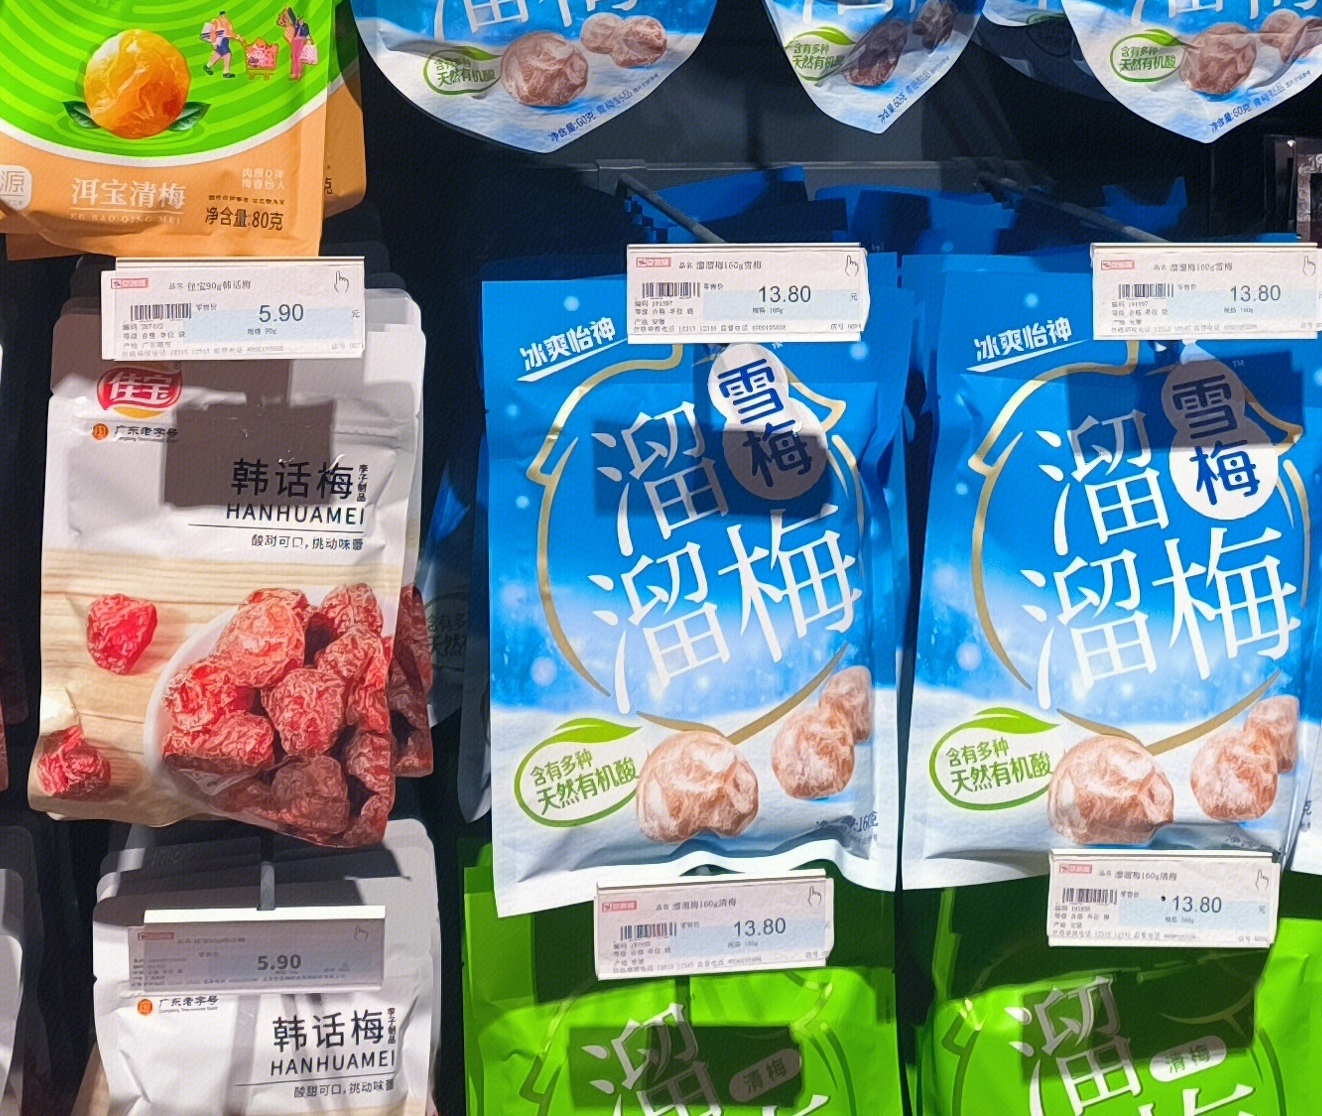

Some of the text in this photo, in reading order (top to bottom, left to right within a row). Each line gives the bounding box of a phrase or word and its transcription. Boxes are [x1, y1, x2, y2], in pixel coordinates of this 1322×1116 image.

[1118, 53, 1178, 73] 天然有机酸
[70, 176, 187, 211] 洱宝清梅
[204, 204, 284, 232] 净含量:80克
[259, 301, 305, 323] 5.90
[757, 283, 812, 304] 13.80
[1229, 283, 1282, 304] 13.80
[518, 314, 618, 372] 冰爽怡神
[974, 316, 1074, 362] 冰爽怡神
[105, 370, 177, 409] 佳宝
[717, 357, 817, 488] 雪梅
[1171, 374, 1262, 506] 雪梅
[229, 456, 355, 501] 韩话梅
[589, 400, 730, 558] 溜
[1033, 408, 1171, 557] 溜
[224, 501, 367, 529] HANHUAMEI
[586, 503, 864, 716] 溜梅
[1019, 524, 1302, 711] 溜梅
[529, 748, 595, 787] 含有多种
[944, 735, 1011, 768] 含有多种
[536, 756, 640, 815] 天然有机酸
[949, 749, 1056, 798] 天然有机酸
[1172, 894, 1224, 914] 13.80
[733, 916, 788, 938] 13.80
[257, 953, 303, 972] 5.90
[271, 1006, 385, 1054] 韩话梅
[269, 1049, 397, 1078] HANHUAMEI
